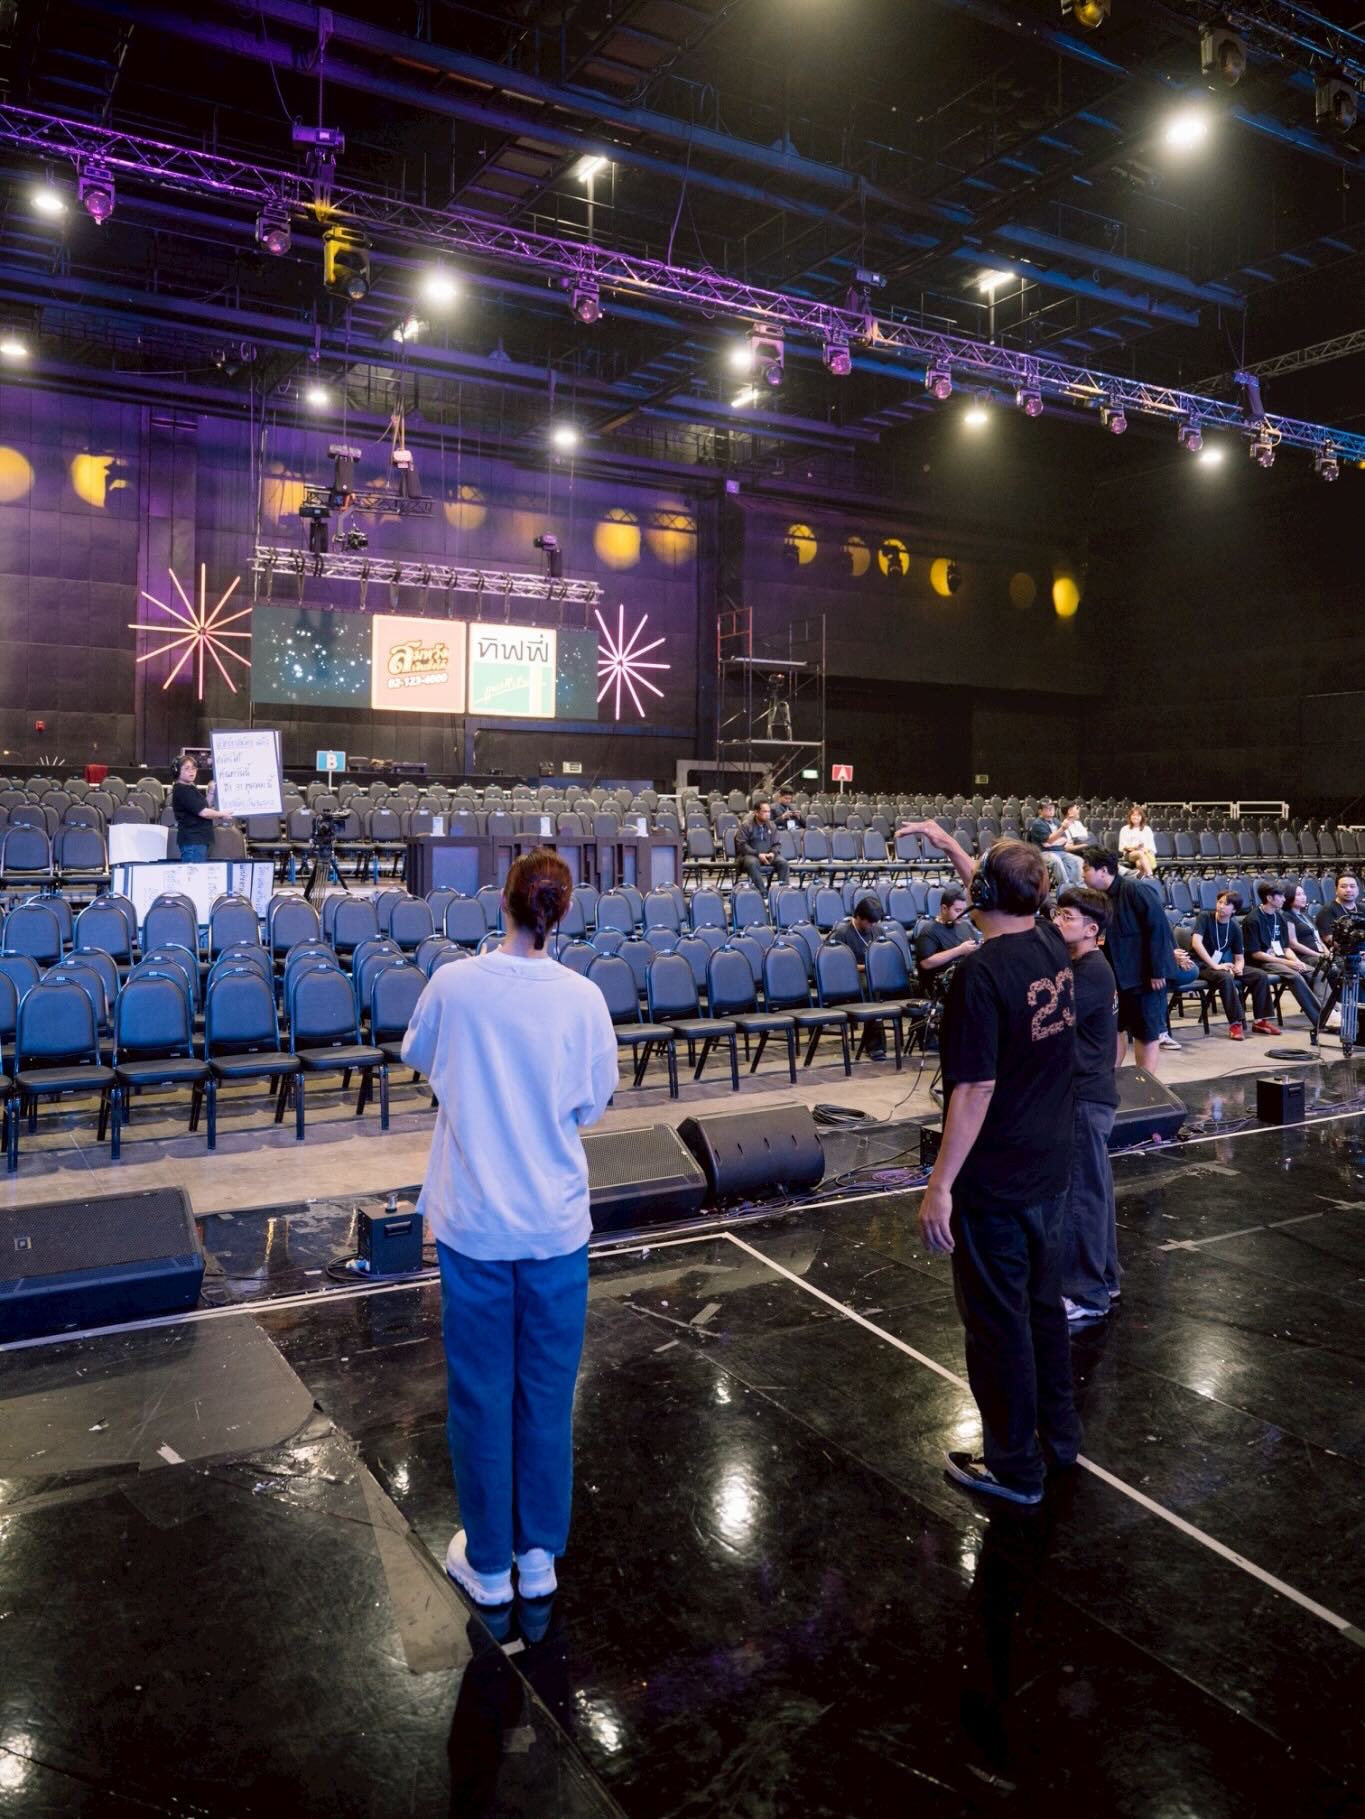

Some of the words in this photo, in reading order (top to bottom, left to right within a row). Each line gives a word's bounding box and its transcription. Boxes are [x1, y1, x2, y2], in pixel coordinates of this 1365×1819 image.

[477, 633, 549, 663] ทิฟฟี่
[326, 754, 338, 770] B
[837, 767, 849, 780] A
